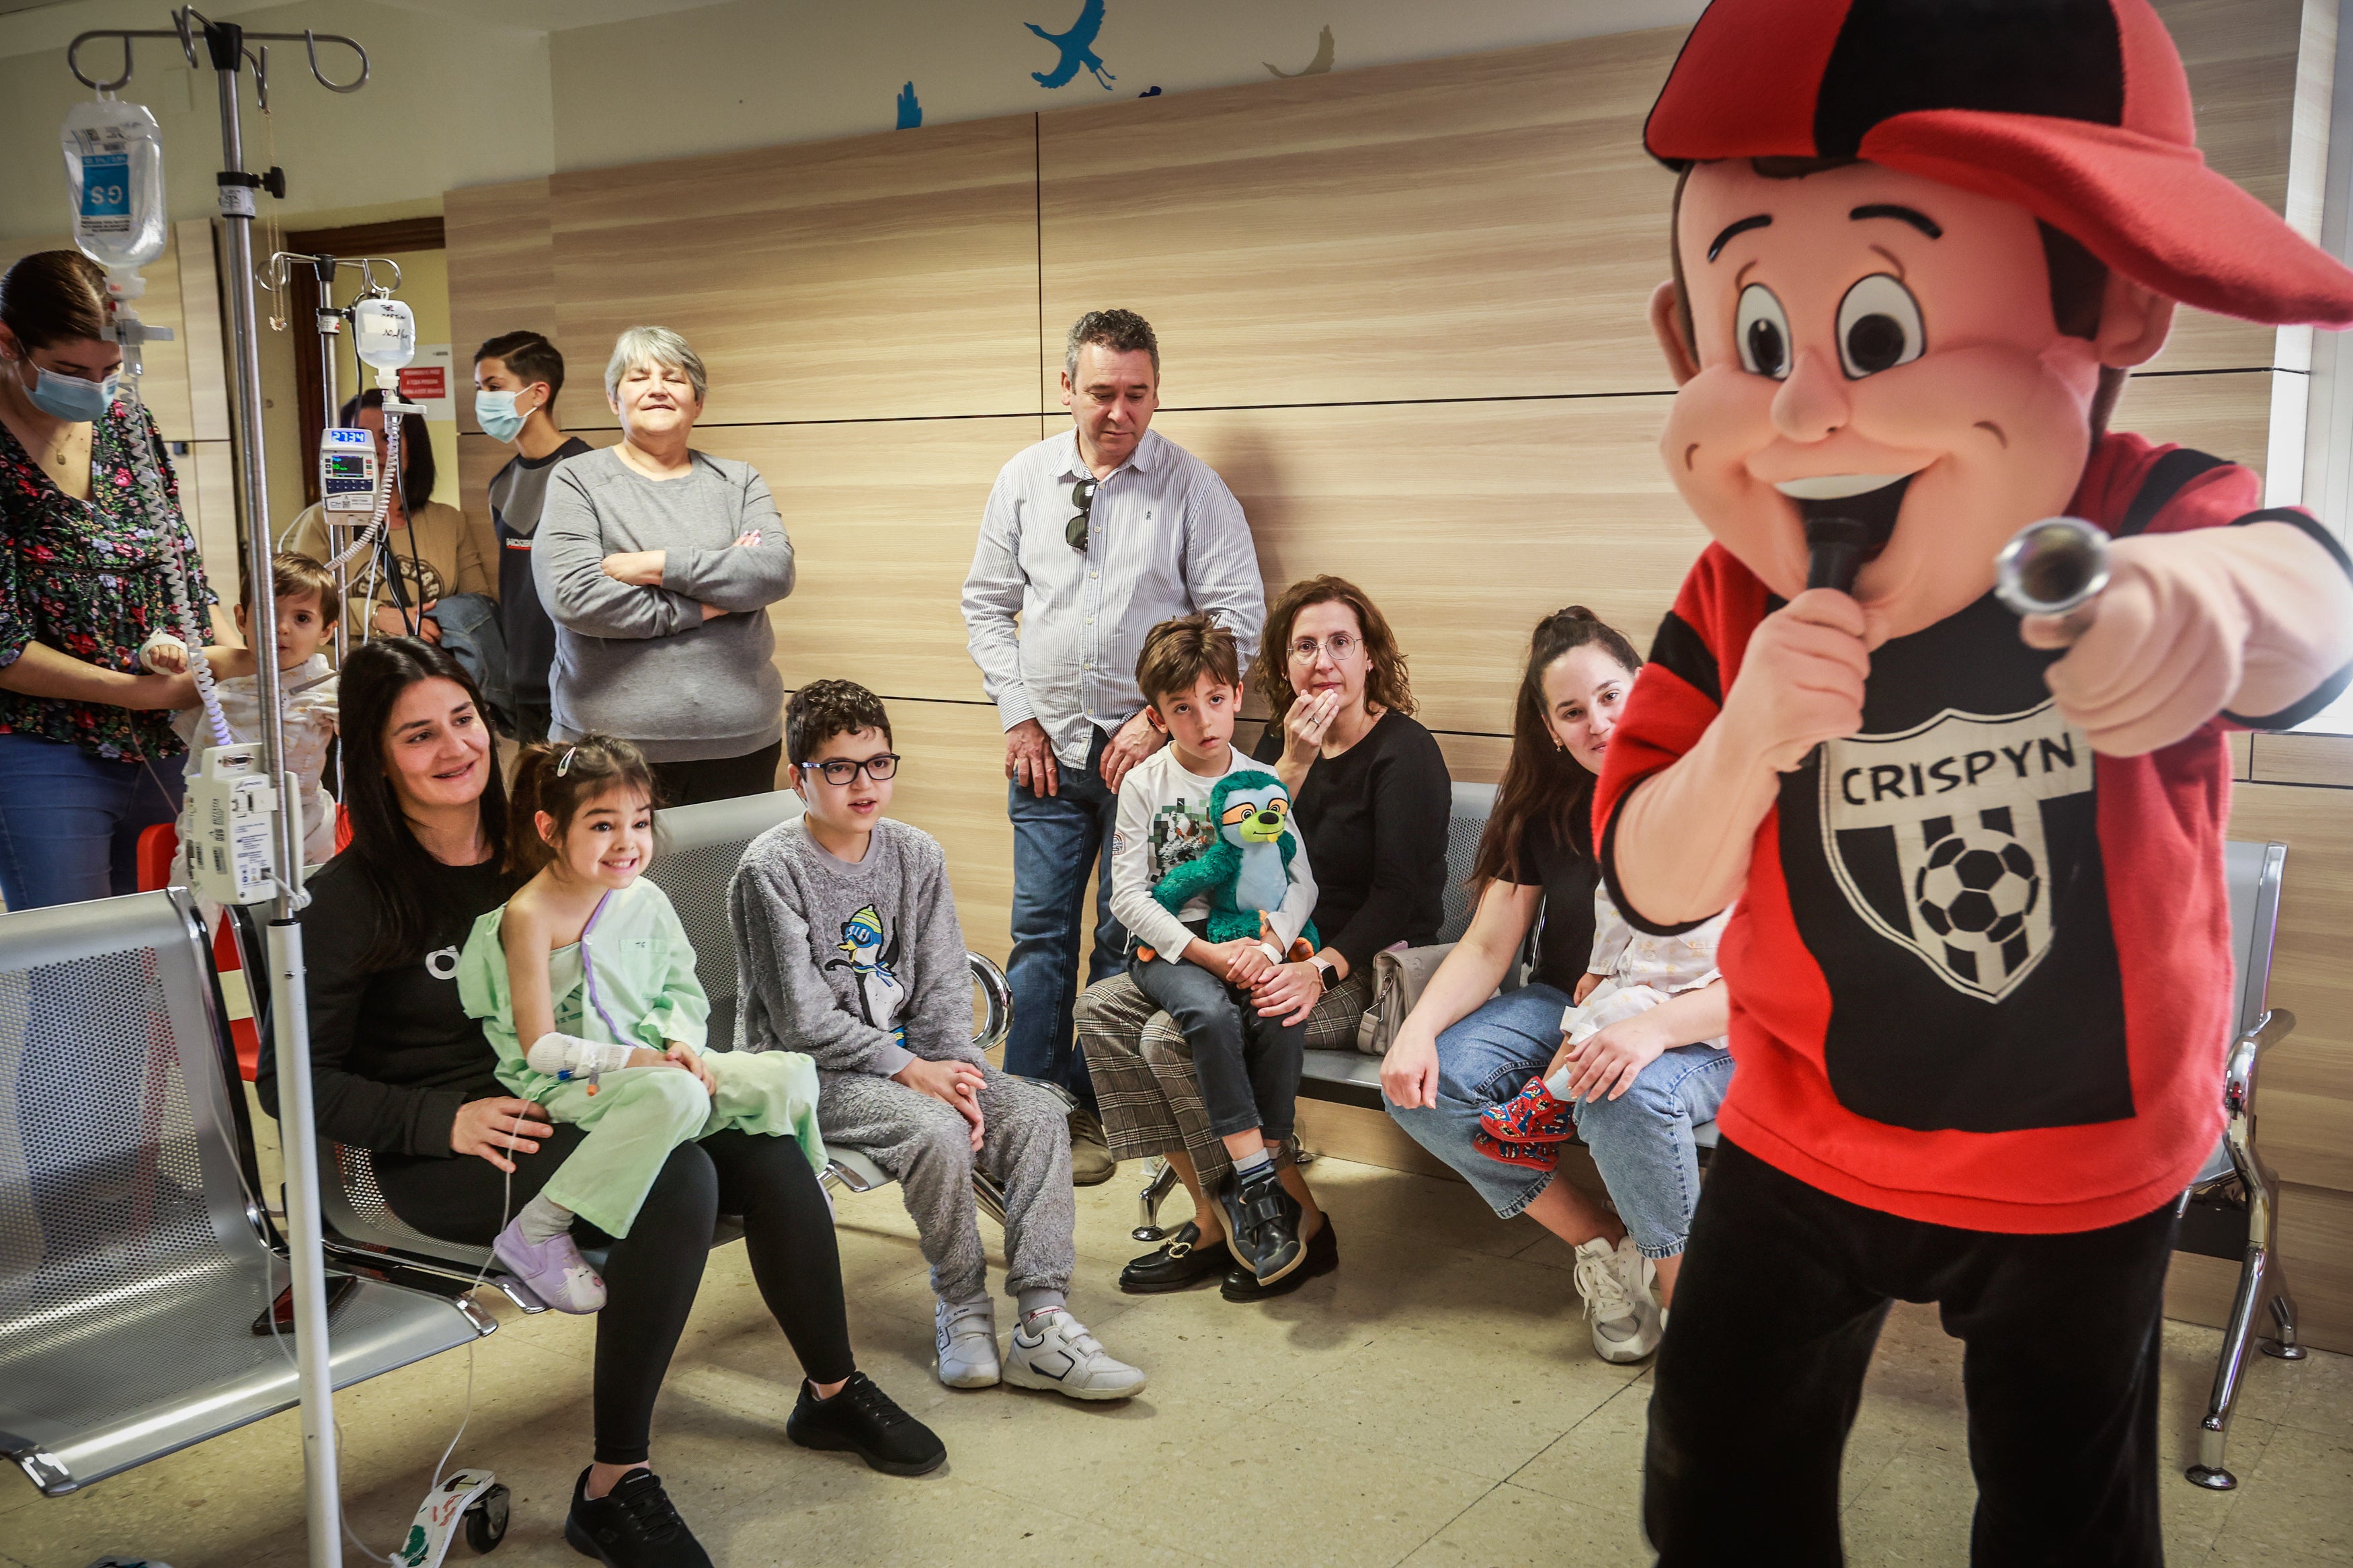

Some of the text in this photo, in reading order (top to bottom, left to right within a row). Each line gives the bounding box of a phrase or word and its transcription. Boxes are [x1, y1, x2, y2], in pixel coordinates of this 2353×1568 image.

[90, 185, 123, 205] GS
[332, 431, 364, 442] 2734
[1841, 732, 2076, 806] CRISPYN
